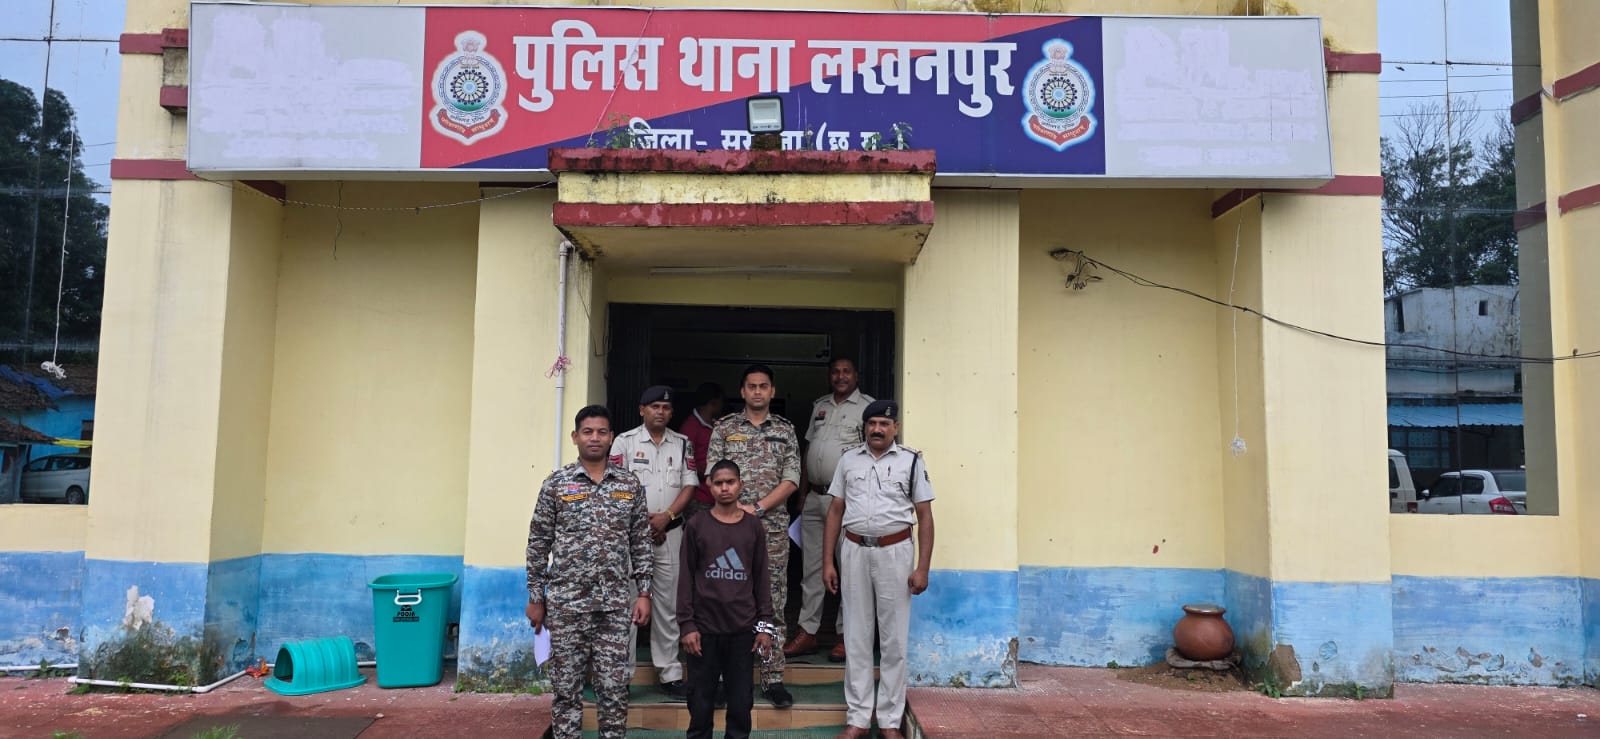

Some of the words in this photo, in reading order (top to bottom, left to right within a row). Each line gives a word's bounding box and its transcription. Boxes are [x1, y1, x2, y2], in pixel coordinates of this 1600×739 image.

[513, 19, 664, 112] पुलिस
[679, 36, 795, 93] थाना
[808, 39, 1017, 118] लखनपुर
[705, 568, 748, 581] adidas
